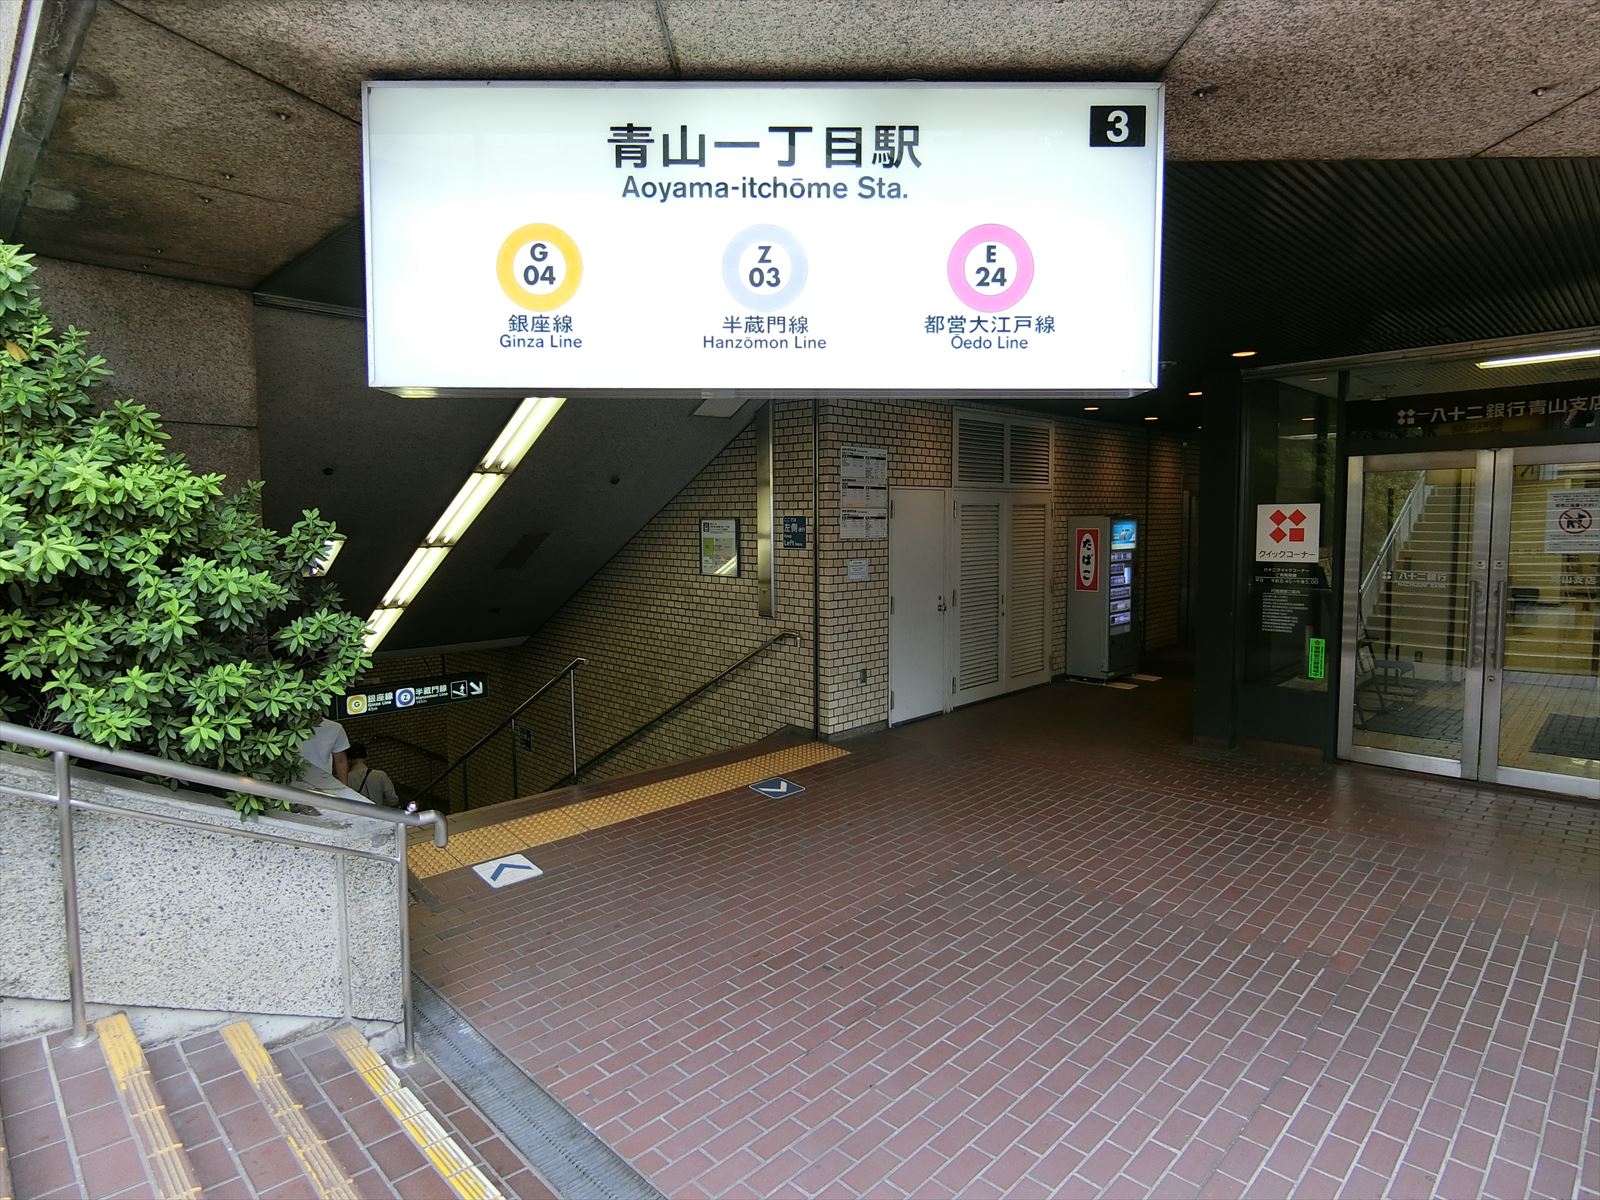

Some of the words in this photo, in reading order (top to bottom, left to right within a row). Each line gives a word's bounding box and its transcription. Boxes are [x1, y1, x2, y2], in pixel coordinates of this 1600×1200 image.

[1106, 110, 1129, 142] 3
[607, 123, 922, 168] 青山一丁目駅
[622, 176, 847, 203] Aoyama-itchōme
[858, 178, 908, 200] Sta.
[529, 242, 549, 263] G
[757, 245, 772, 264] Z
[986, 245, 998, 264] E
[523, 264, 556, 286] 04
[748, 266, 781, 287] 03
[975, 266, 1008, 287] 24
[508, 314, 574, 334] 銀座線
[722, 315, 810, 335] 半蔵門線
[924, 314, 1056, 334] 都営大江戸線
[499, 333, 545, 349] Ginza
[550, 333, 583, 349] Line
[703, 335, 788, 350] Hanzōmon
[794, 335, 827, 350] Line
[950, 333, 992, 349] Ōedo
[997, 335, 1029, 349] Line
[1082, 538, 1094, 580] たばこ
[1258, 550, 1316, 559] クイックコーナー
[1552, 575, 1599, 585] 山支店
[416, 684, 448, 697] 半蔵門線
